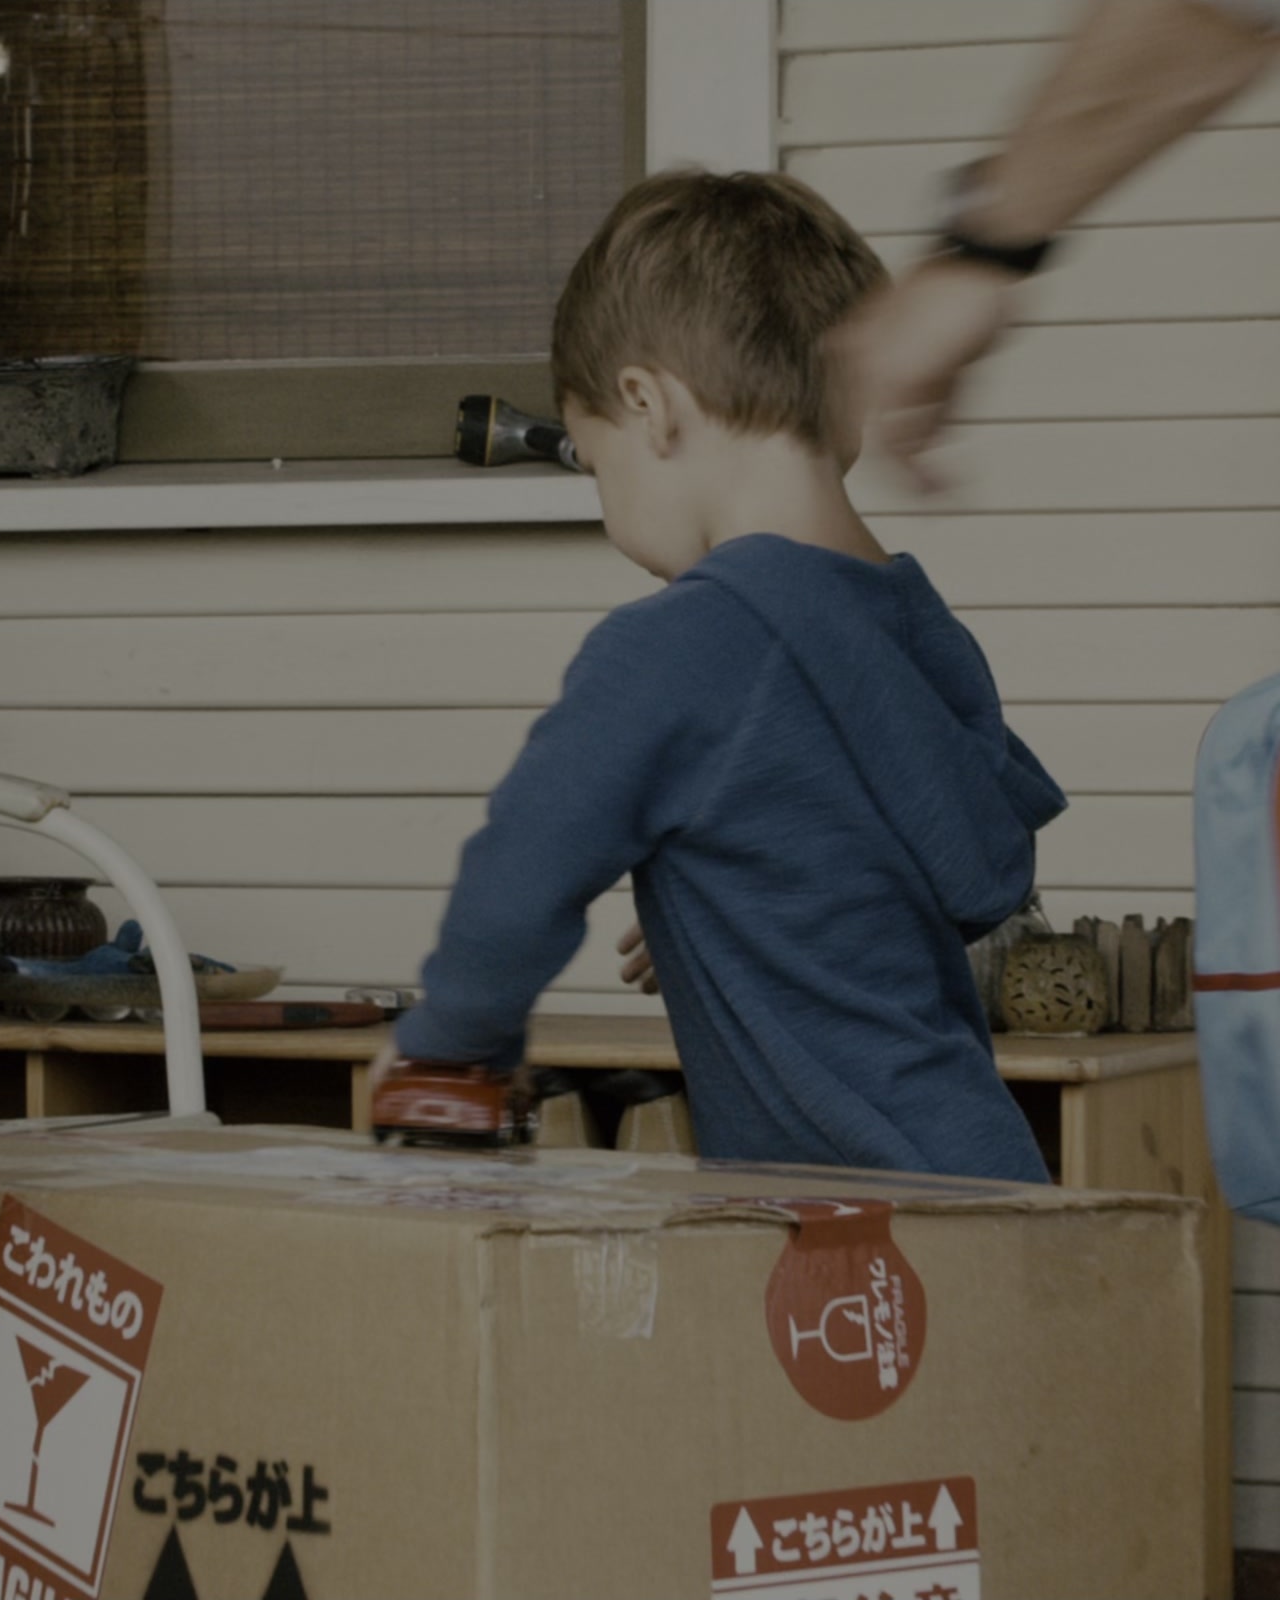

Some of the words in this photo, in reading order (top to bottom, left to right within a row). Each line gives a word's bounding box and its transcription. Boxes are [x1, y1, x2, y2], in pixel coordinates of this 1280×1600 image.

[2, 1224, 144, 1340] こわれもの
[889, 1274, 910, 1369] FRAGILE
[132, 1449, 332, 1535] こちらが上
[771, 1500, 927, 1563] こちらが上
